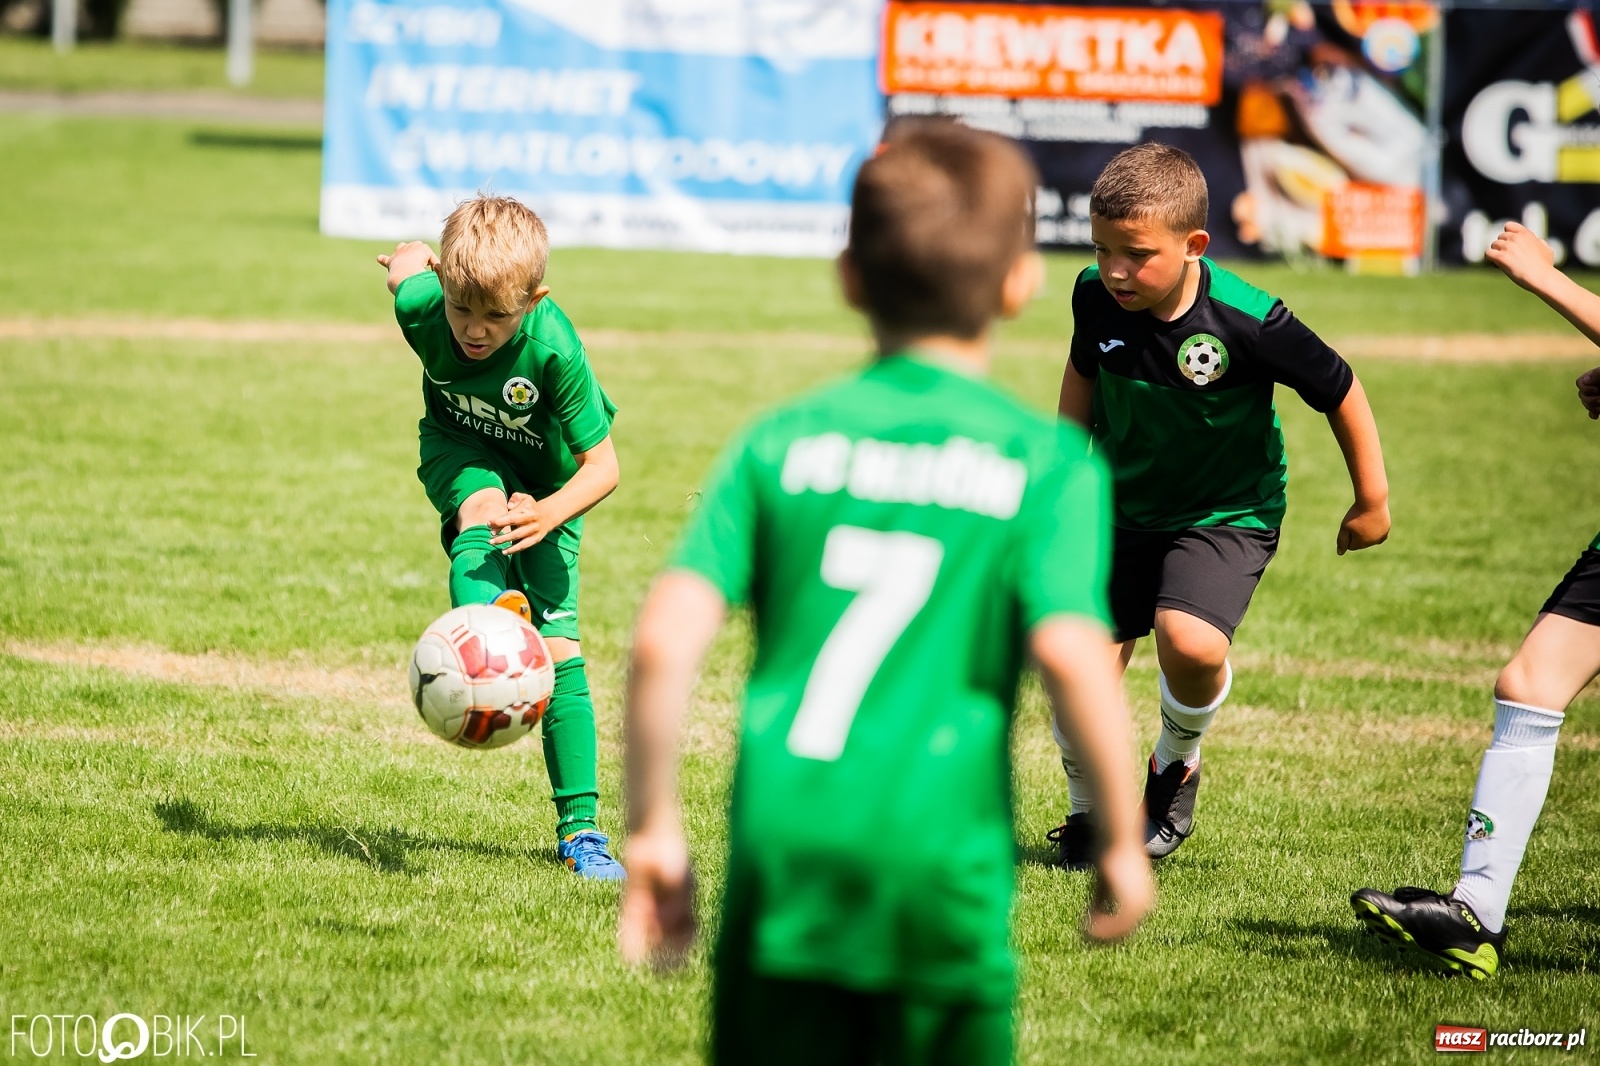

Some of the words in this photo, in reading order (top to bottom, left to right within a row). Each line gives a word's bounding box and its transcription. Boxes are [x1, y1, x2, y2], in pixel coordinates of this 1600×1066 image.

[895, 12, 1207, 73] KREWETKA
[367, 63, 640, 117] INTERNET
[786, 524, 945, 762] 7
[1461, 909, 1481, 933] COPA
